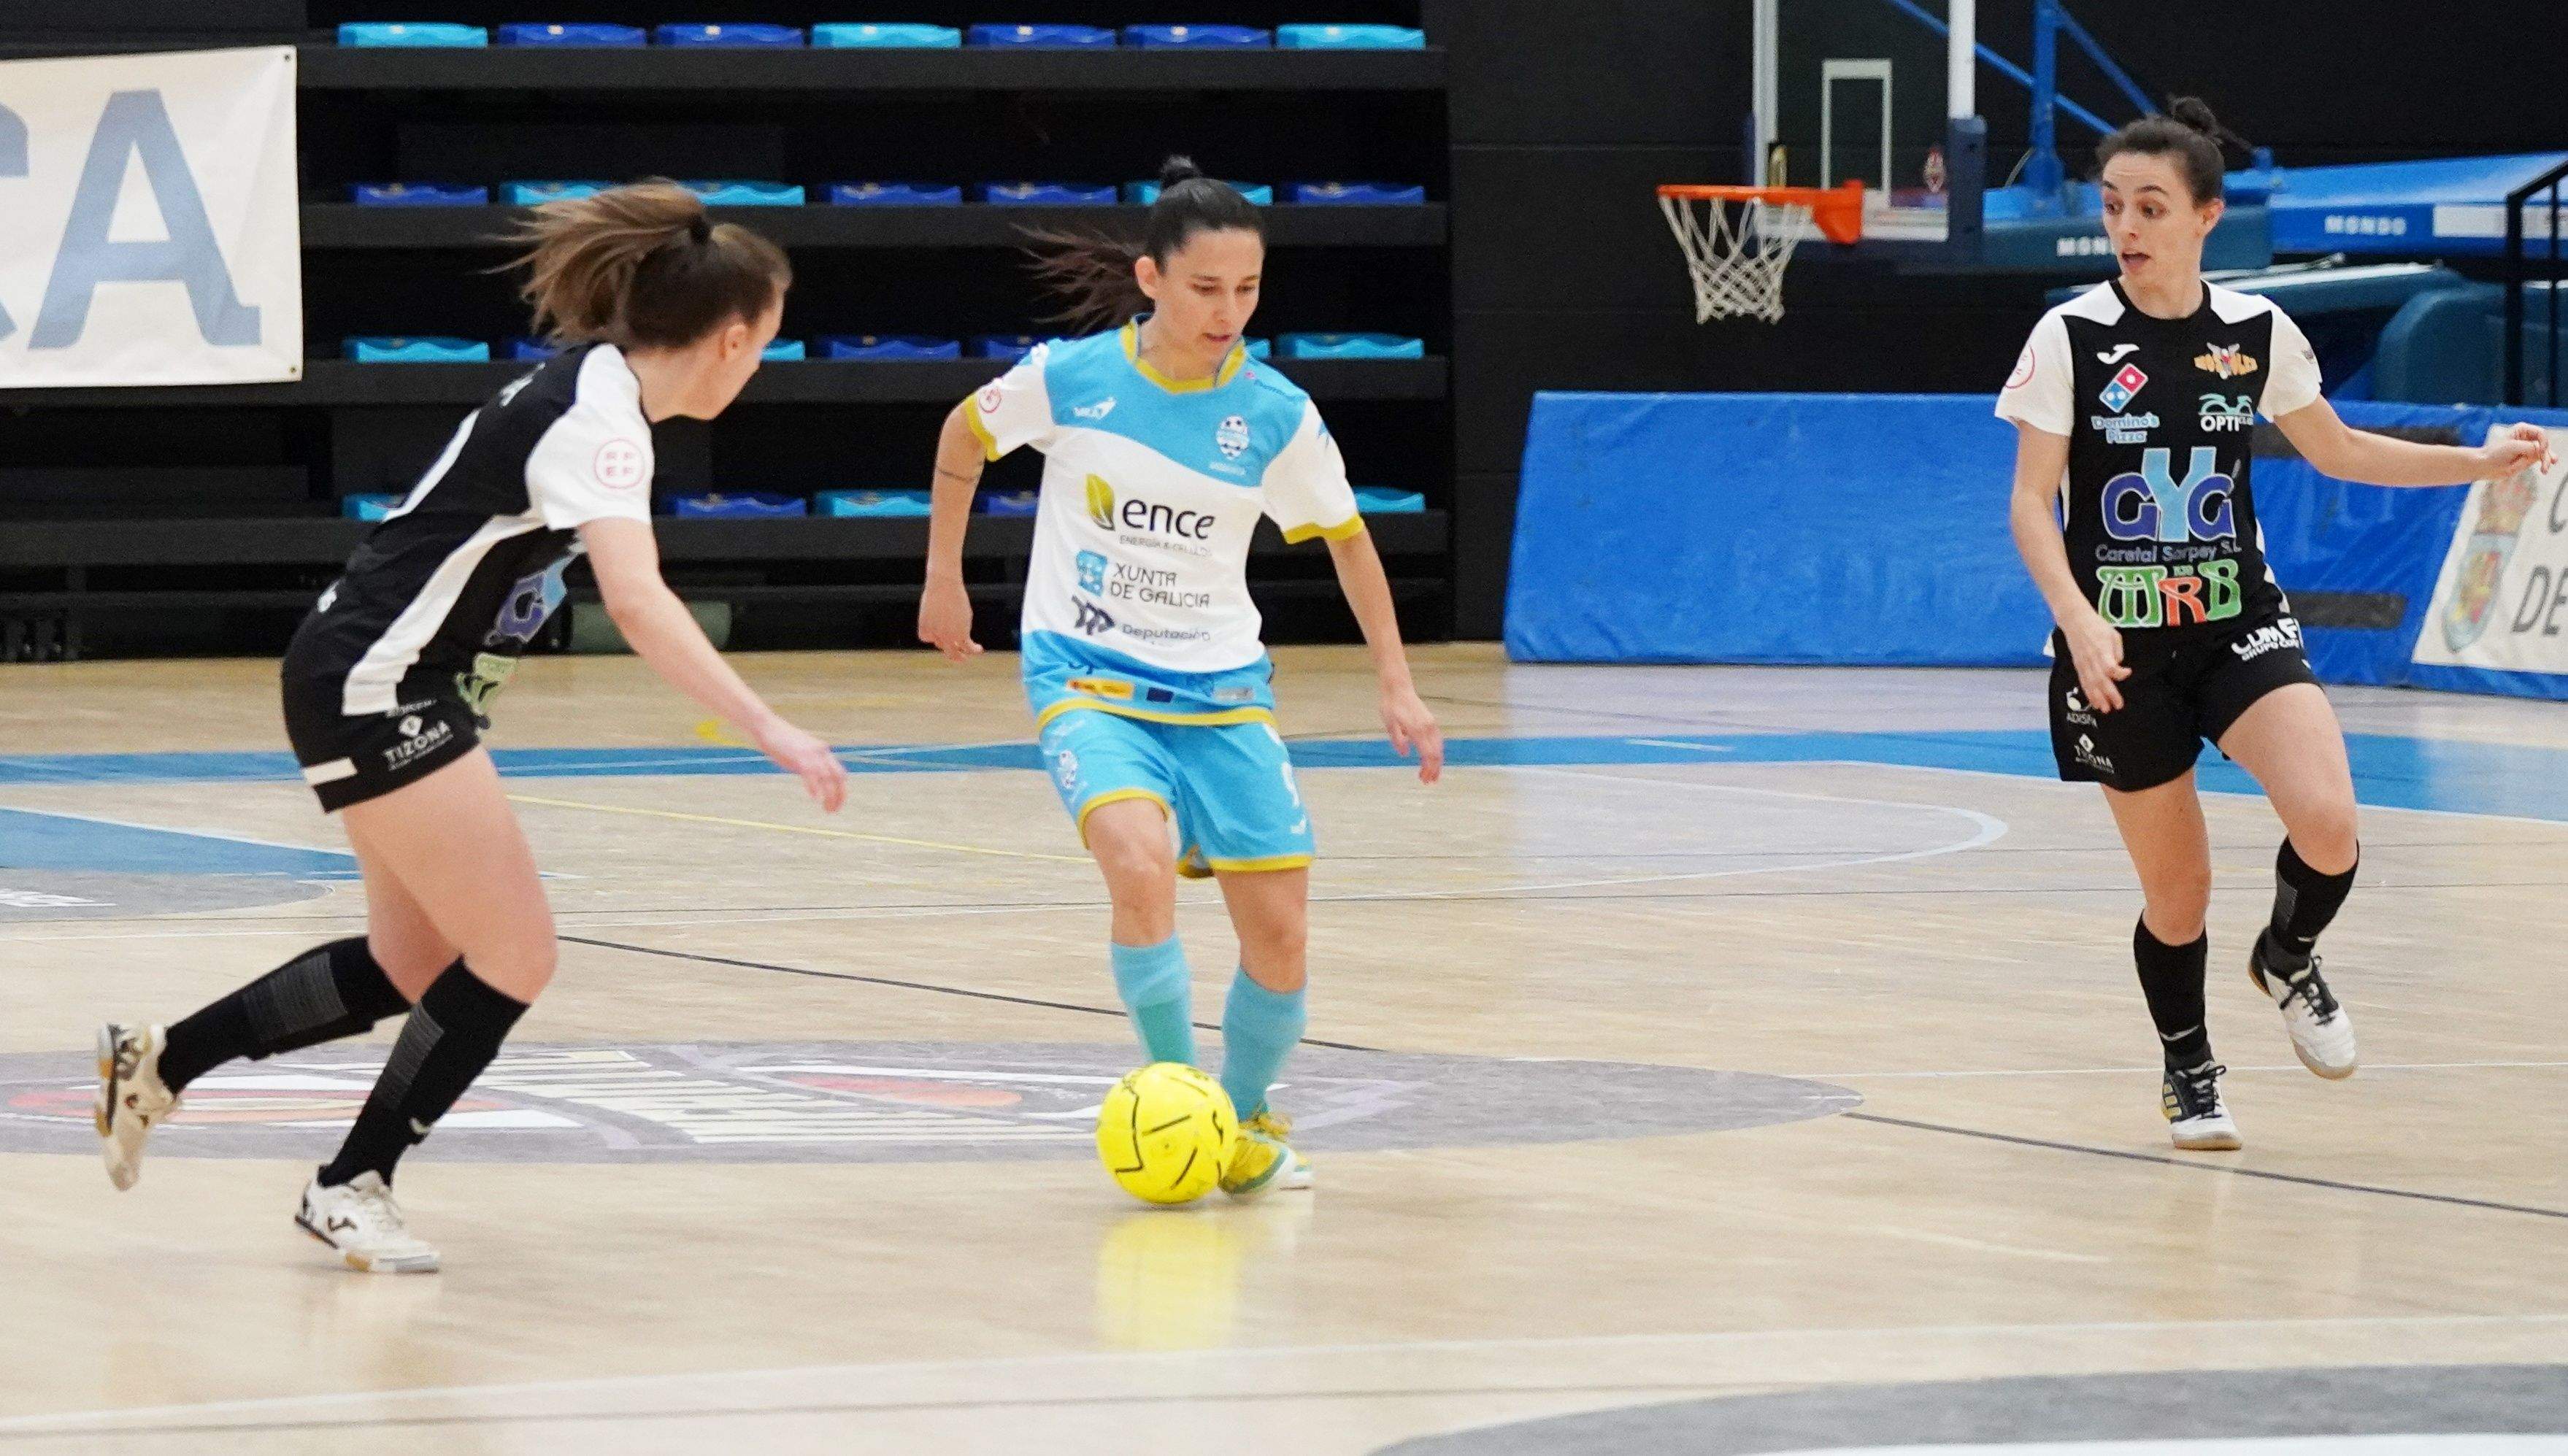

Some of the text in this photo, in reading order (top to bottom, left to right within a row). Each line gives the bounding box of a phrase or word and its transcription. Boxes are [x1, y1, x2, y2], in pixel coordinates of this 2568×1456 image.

[0, 89, 261, 350] A
[1123, 499, 1215, 540] ence
[1110, 581, 1212, 609] DE GALICIA
[1113, 562, 1178, 587] XUNTA
[383, 720, 451, 764] TIZONA
